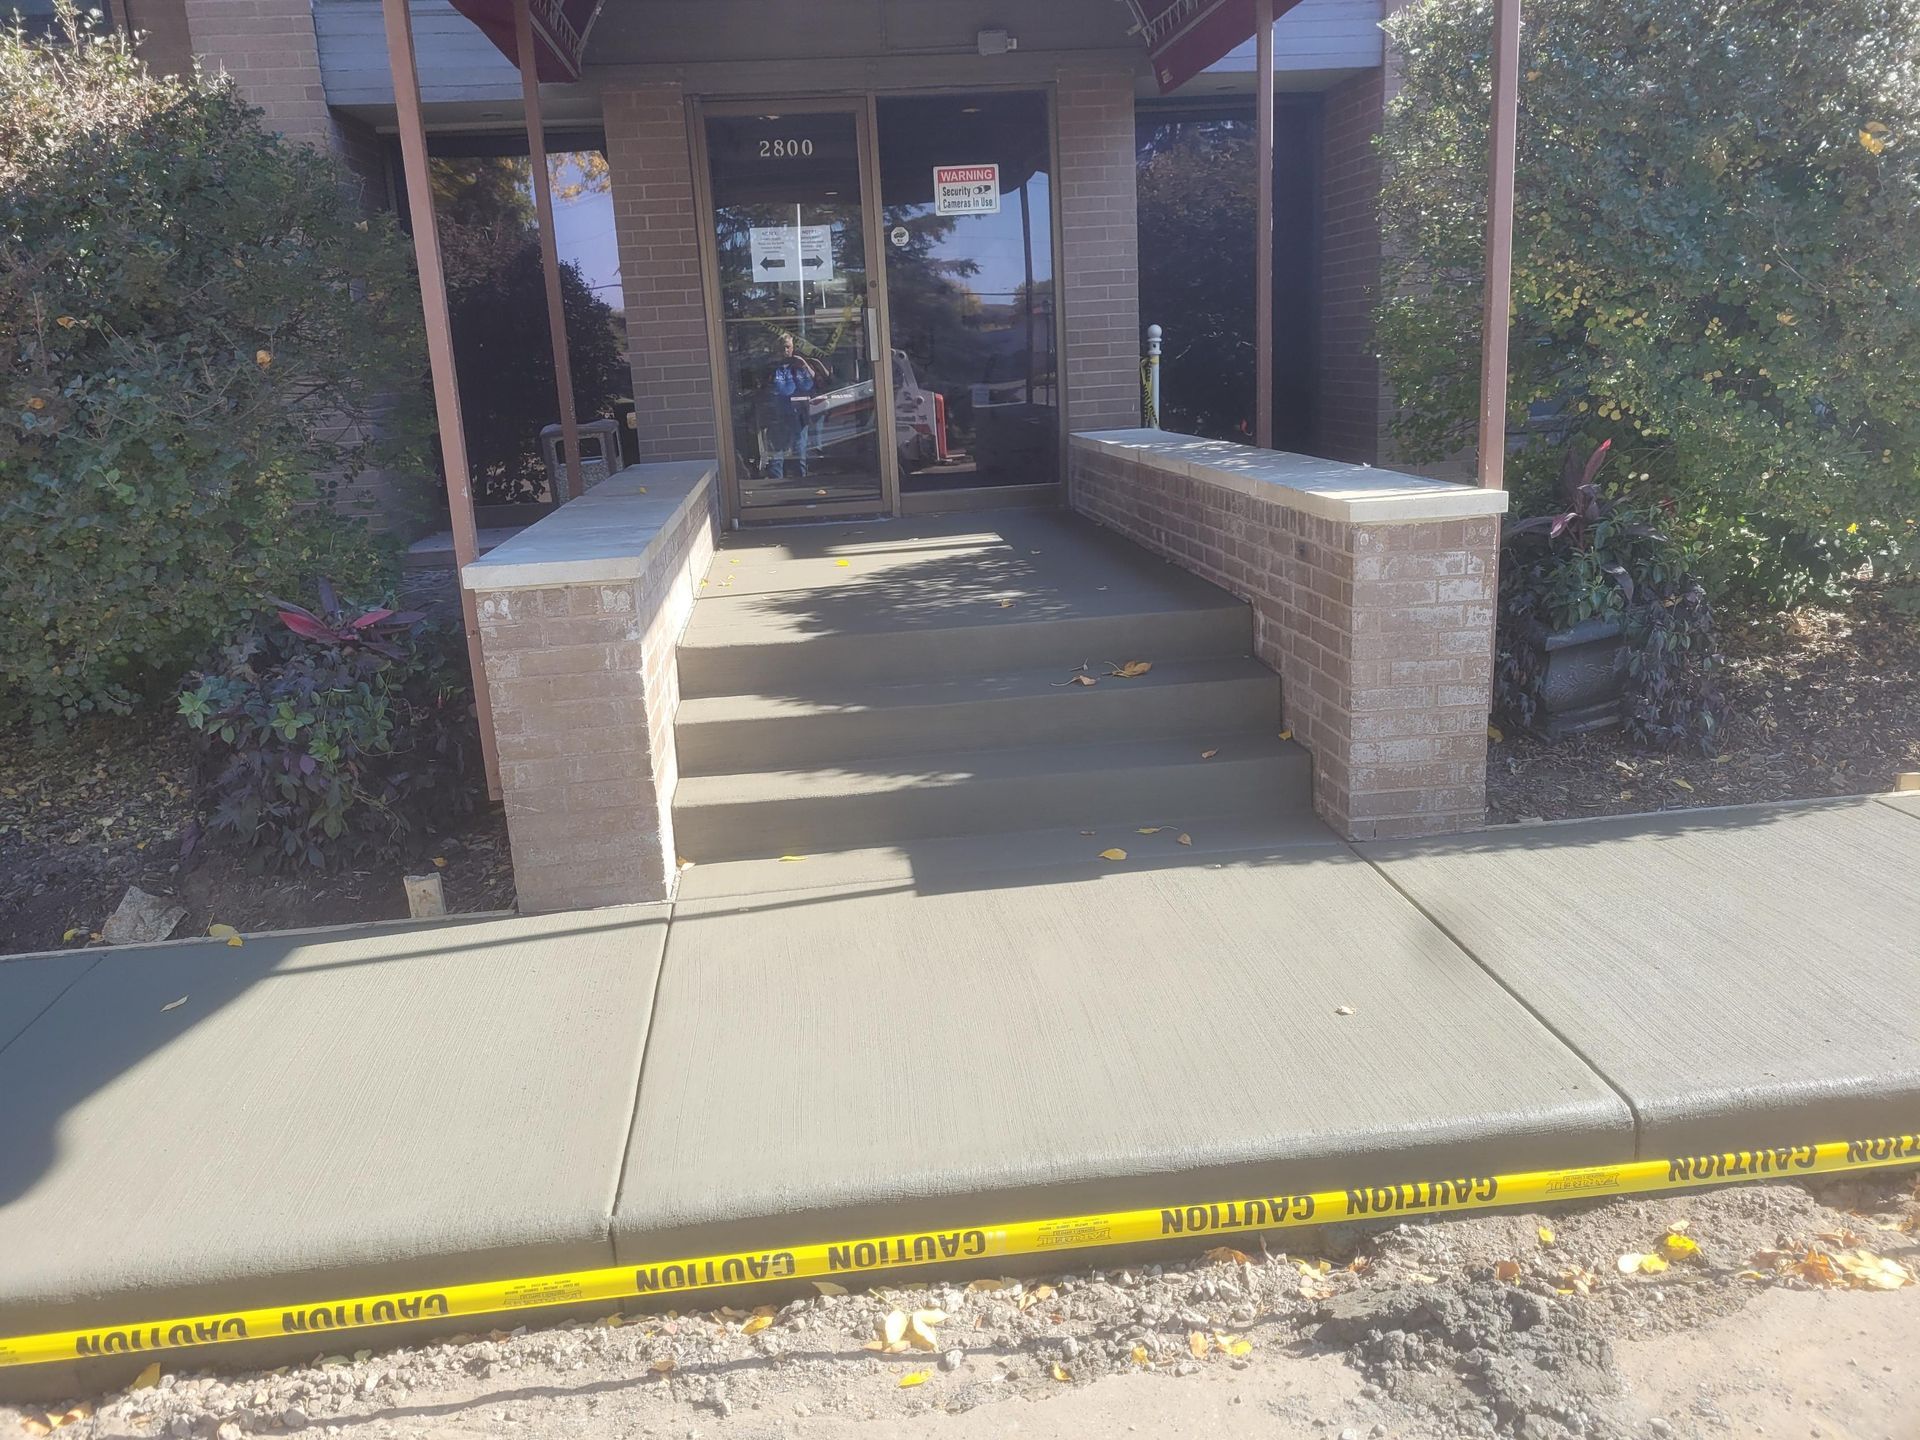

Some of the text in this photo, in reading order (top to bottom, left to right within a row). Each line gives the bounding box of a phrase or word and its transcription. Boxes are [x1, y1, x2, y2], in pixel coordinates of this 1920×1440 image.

[759, 139, 813, 157] 2800
[940, 169, 993, 182] WARNING
[942, 186, 971, 197] Security
[942, 199, 971, 209] Cameras
[980, 197, 993, 207] Use
[1668, 1145, 1817, 1182] CAUTION
[1847, 1136, 1920, 1164] TION
[1161, 1194, 1315, 1234] CAUTION
[1345, 1176, 1498, 1215] CAUTION
[828, 1230, 986, 1271] CAUTION
[636, 1252, 795, 1292] CAUTION
[281, 1294, 450, 1332] CAUTION
[76, 1317, 249, 1356] CAUTION
